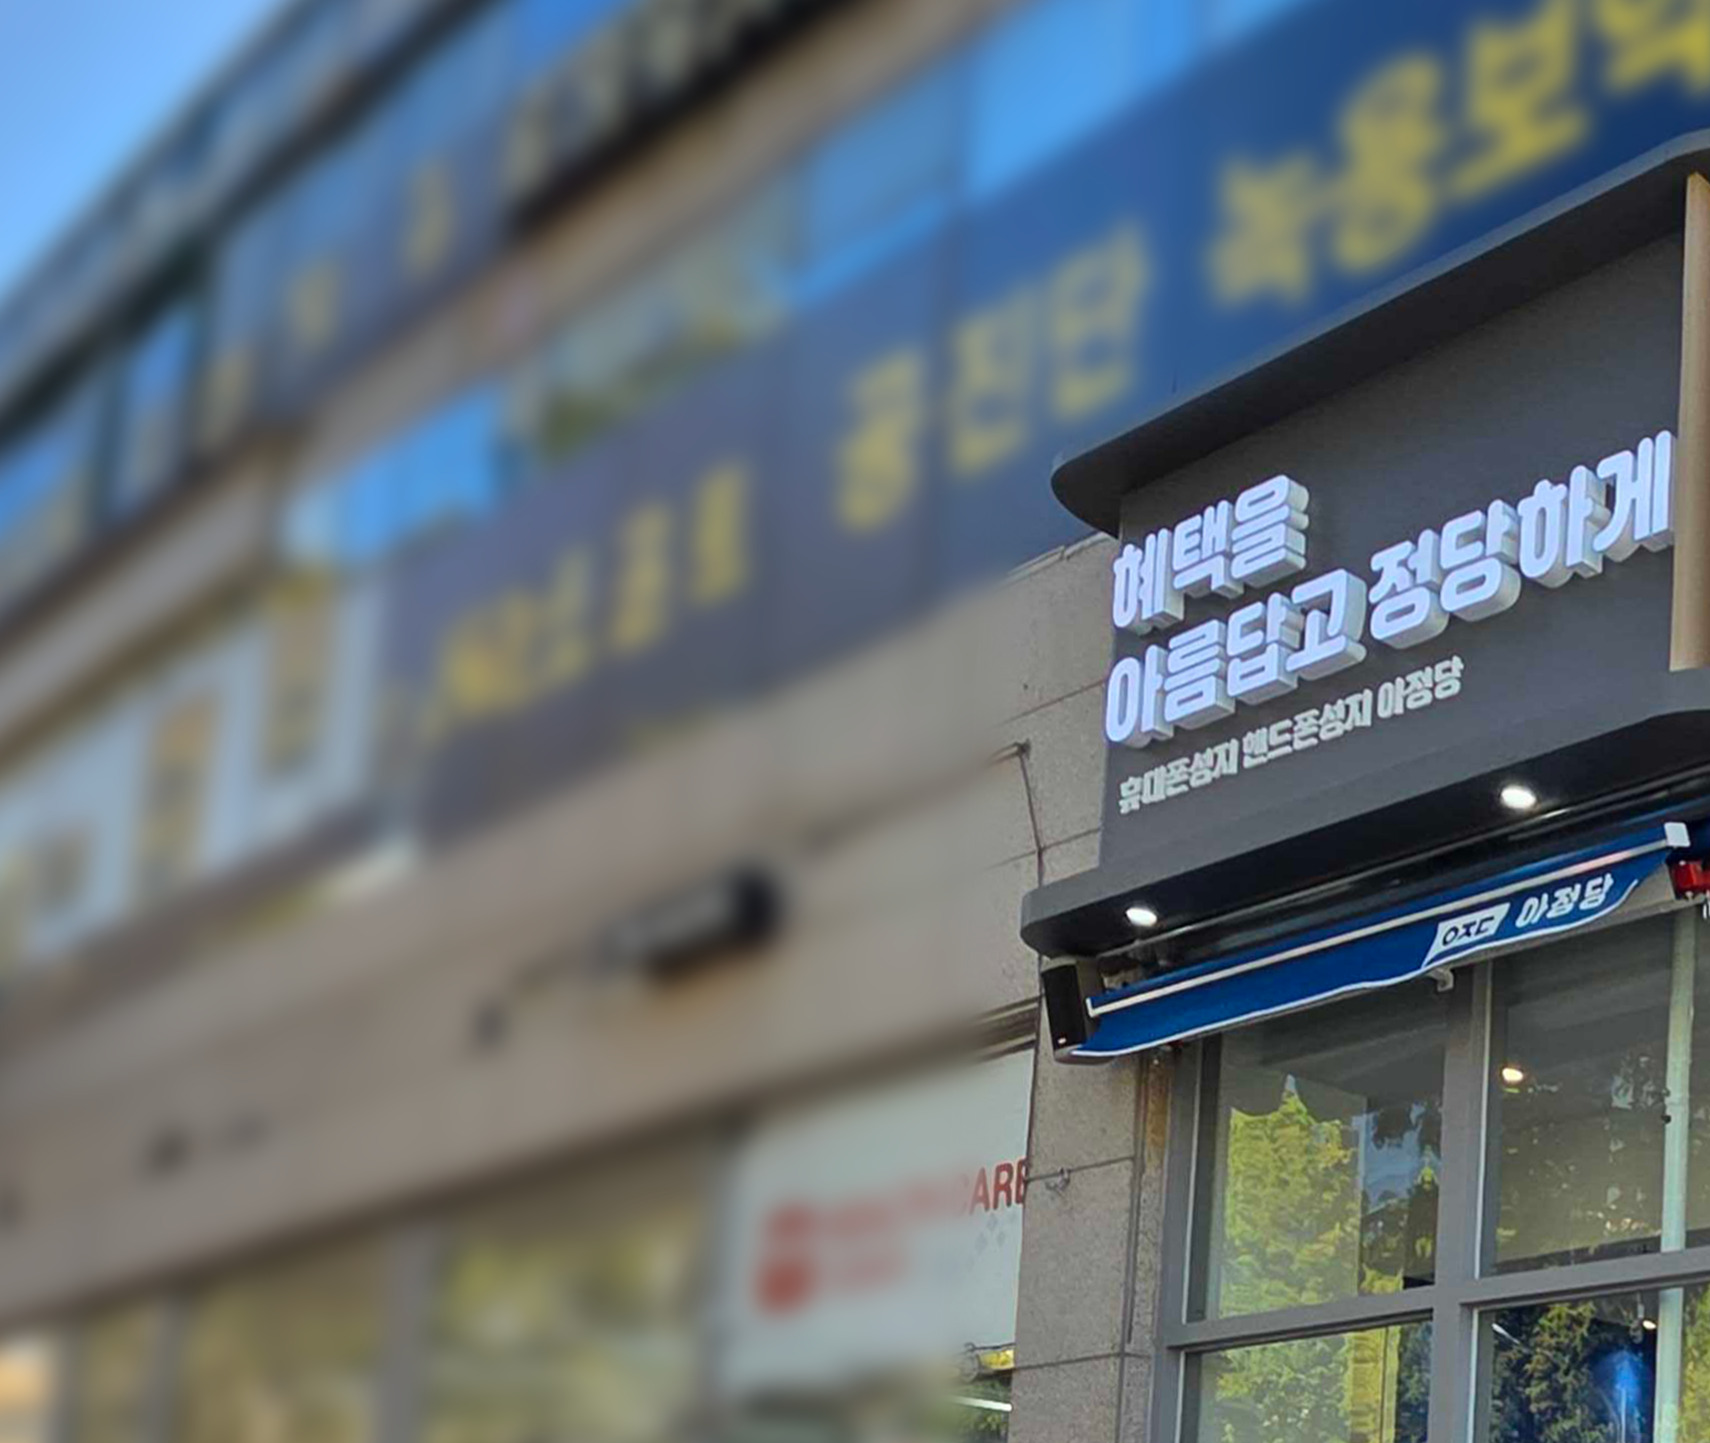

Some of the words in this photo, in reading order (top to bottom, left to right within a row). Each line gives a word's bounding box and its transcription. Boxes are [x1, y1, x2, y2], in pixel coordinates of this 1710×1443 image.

[1105, 569, 1366, 747] 아름답고
[1369, 430, 1676, 648] 정당하게
[1113, 474, 1309, 633] 혜택을
[1118, 737, 1239, 813] 휴대폰성지
[1242, 677, 1372, 768] 핸드폰성지
[1376, 655, 1465, 717] 아정당
[1515, 871, 1614, 928] 아정당
